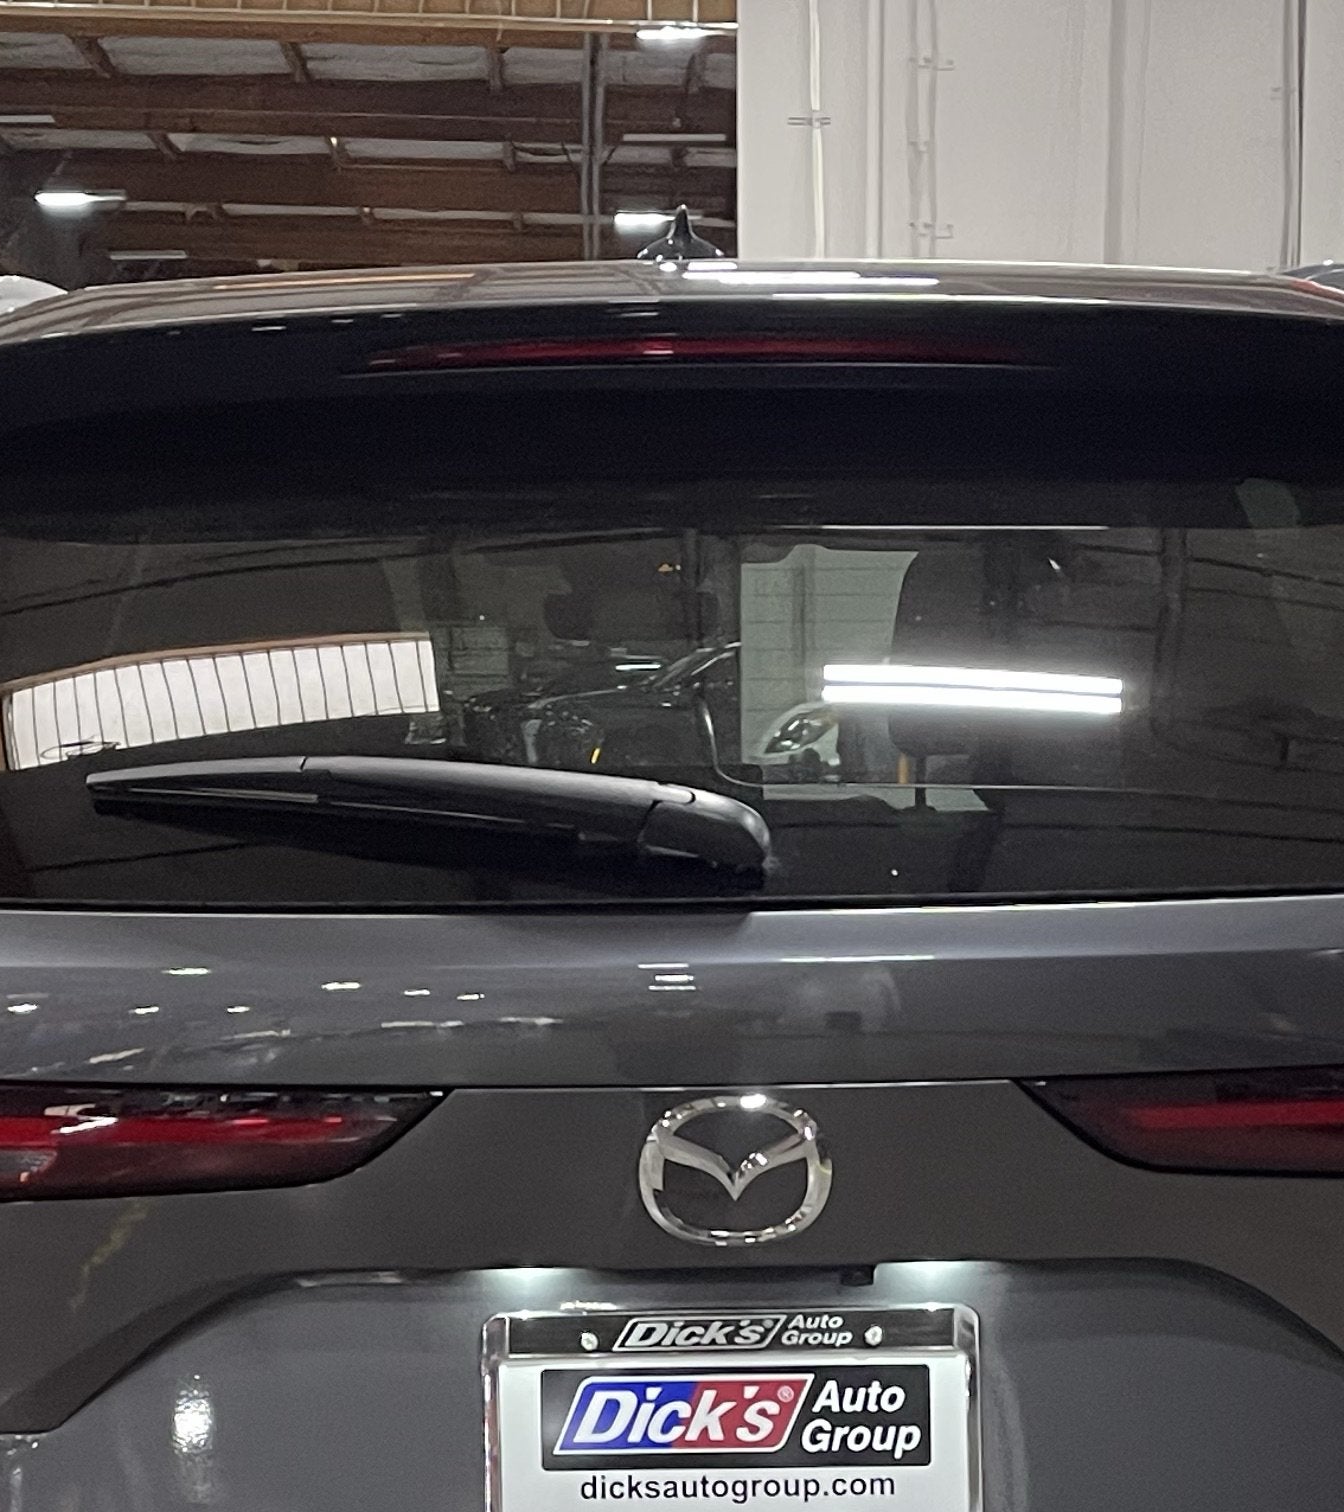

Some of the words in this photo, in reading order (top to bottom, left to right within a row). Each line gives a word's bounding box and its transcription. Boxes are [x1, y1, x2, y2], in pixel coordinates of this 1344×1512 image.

[787, 1314, 844, 1330] Auto
[780, 1329, 854, 1347] Group
[812, 1379, 906, 1414] Auto
[800, 1417, 922, 1459] Group
[580, 1473, 896, 1503] dicksautogroup.com
